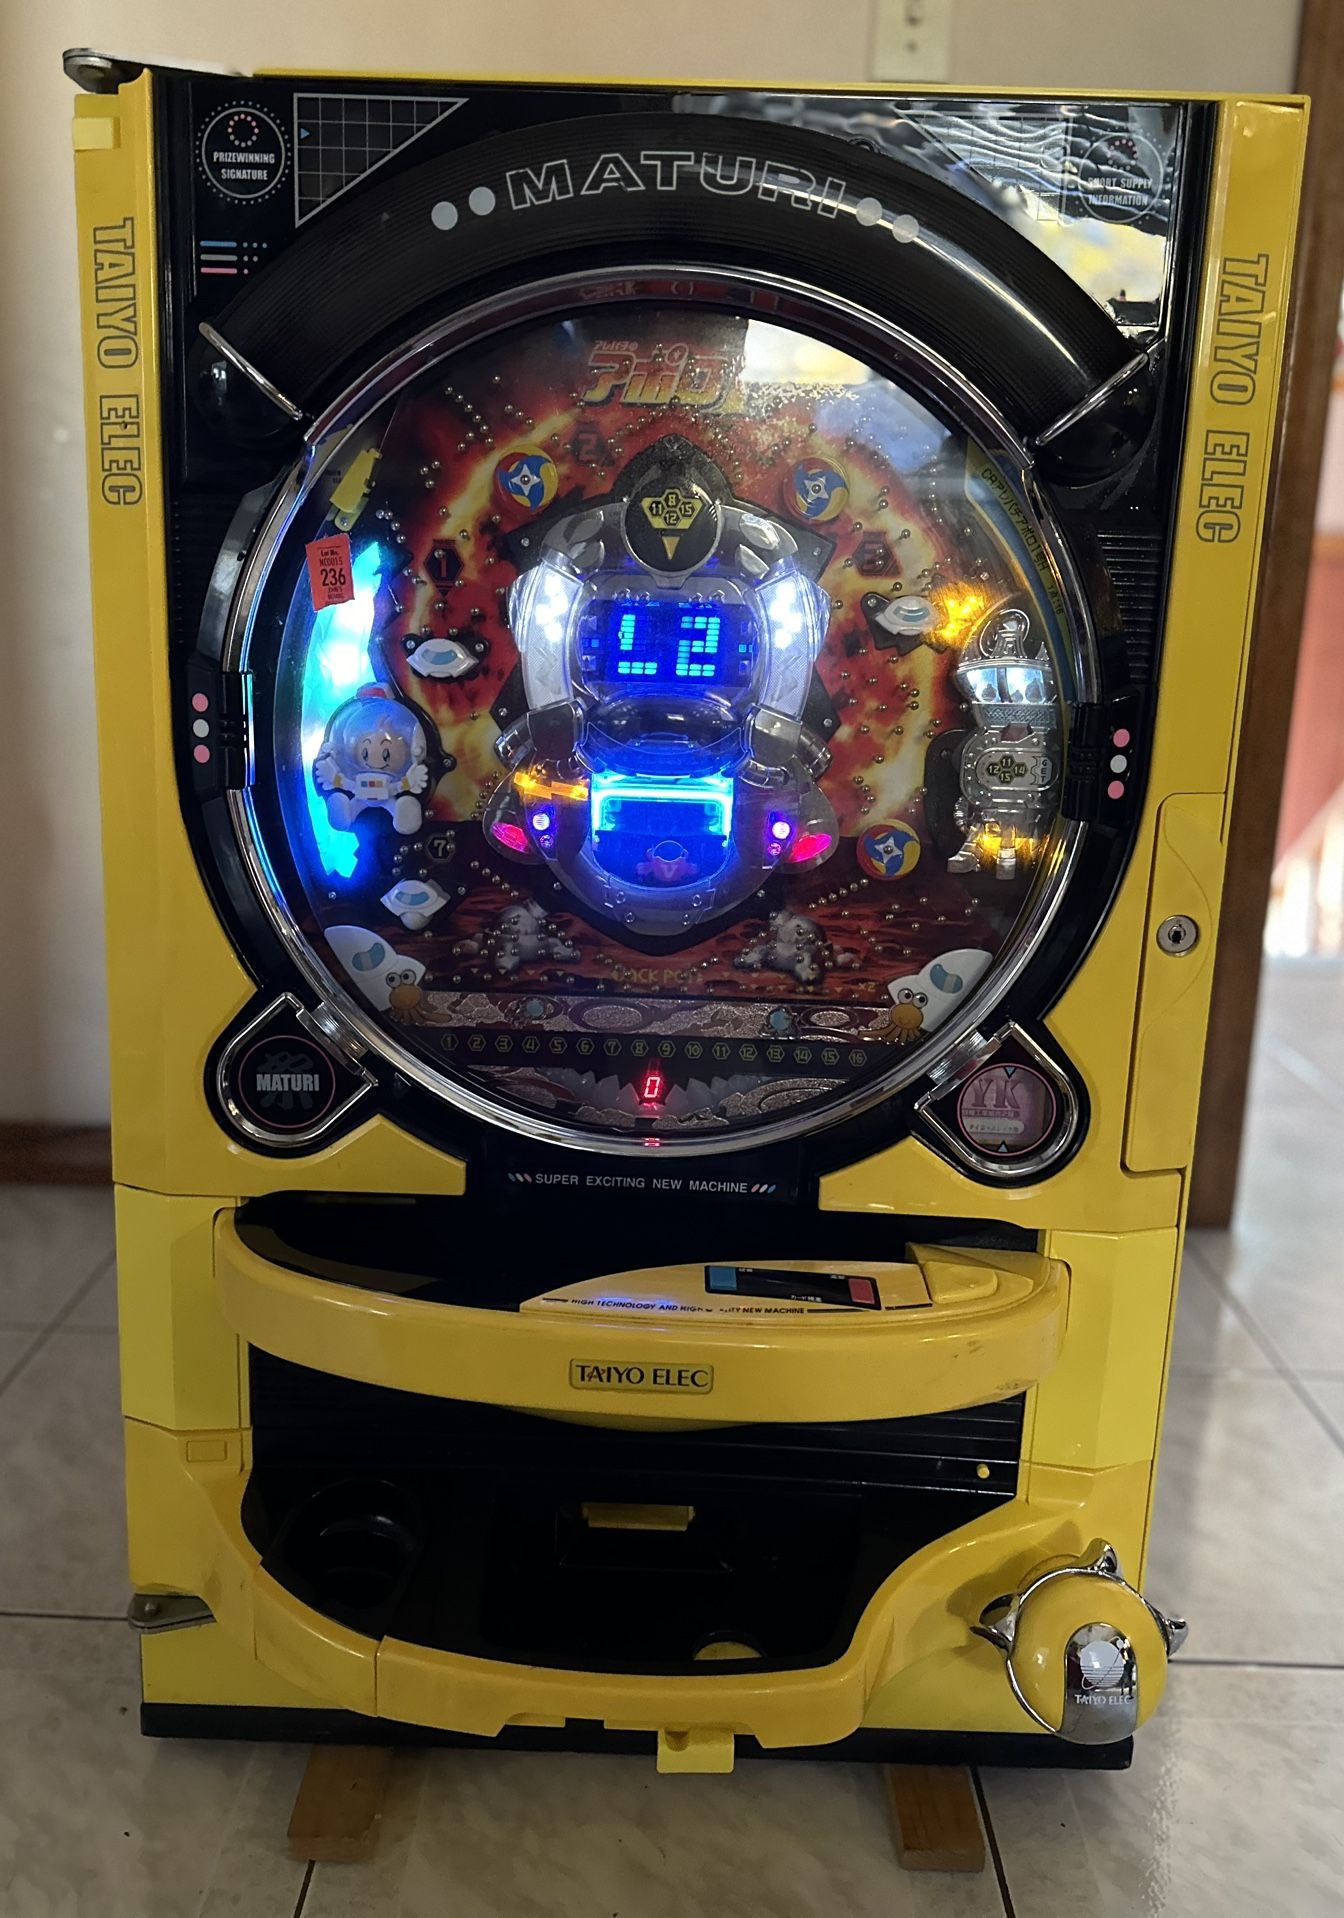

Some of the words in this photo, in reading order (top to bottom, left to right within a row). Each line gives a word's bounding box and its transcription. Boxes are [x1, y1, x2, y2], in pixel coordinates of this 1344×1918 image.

[213, 151, 276, 164] PRIZEWINNING
[221, 168, 268, 180] SIGNATURE
[506, 151, 846, 220] MATURI
[1120, 178, 1154, 189] SUPPLY
[1088, 194, 1149, 207] INFORMATION
[93, 217, 138, 369] TAIYO
[1210, 254, 1269, 406] TAIYO
[99, 394, 143, 506] ELEC
[1196, 430, 1248, 544] ELEC
[651, 503, 663, 514] 11
[681, 504, 693, 514] 15
[668, 494, 676, 506] 8
[665, 513, 677, 523] 12
[320, 568, 346, 587] 236
[988, 764, 1000, 774] 12
[1014, 765, 1026, 775] 14
[1002, 758, 1012, 767] 11
[1000, 772, 1012, 782] 15
[433, 839, 447, 857] 7
[446, 1037, 452, 1047] 1
[473, 1037, 482, 1048] 2
[499, 1038, 508, 1049] 3
[527, 1039, 535, 1050] 4
[554, 1040, 563, 1050] 5
[581, 1041, 589, 1052] 6
[608, 1042, 617, 1053] 7
[635, 1042, 644, 1054] 8
[662, 1044, 671, 1056] 9
[688, 1044, 699, 1056] 10
[715, 1045, 727, 1057] 11
[743, 1046, 754, 1058] 12
[824, 1050, 836, 1063] 15
[852, 1051, 864, 1064] 16
[256, 1073, 320, 1092] MATURI
[644, 1076, 660, 1098] 0
[971, 1077, 1022, 1109] YK
[535, 1173, 579, 1186] SUPER
[586, 1175, 646, 1189] EXCITING
[652, 1178, 683, 1190] NEW
[689, 1180, 749, 1193] MACHINE
[597, 1300, 656, 1310] TECHNOLOGY
[575, 1365, 645, 1386] TAIYO
[652, 1368, 710, 1388] ELEC
[1074, 1694, 1107, 1705] TAIYO
[1109, 1695, 1131, 1705] ELEC
